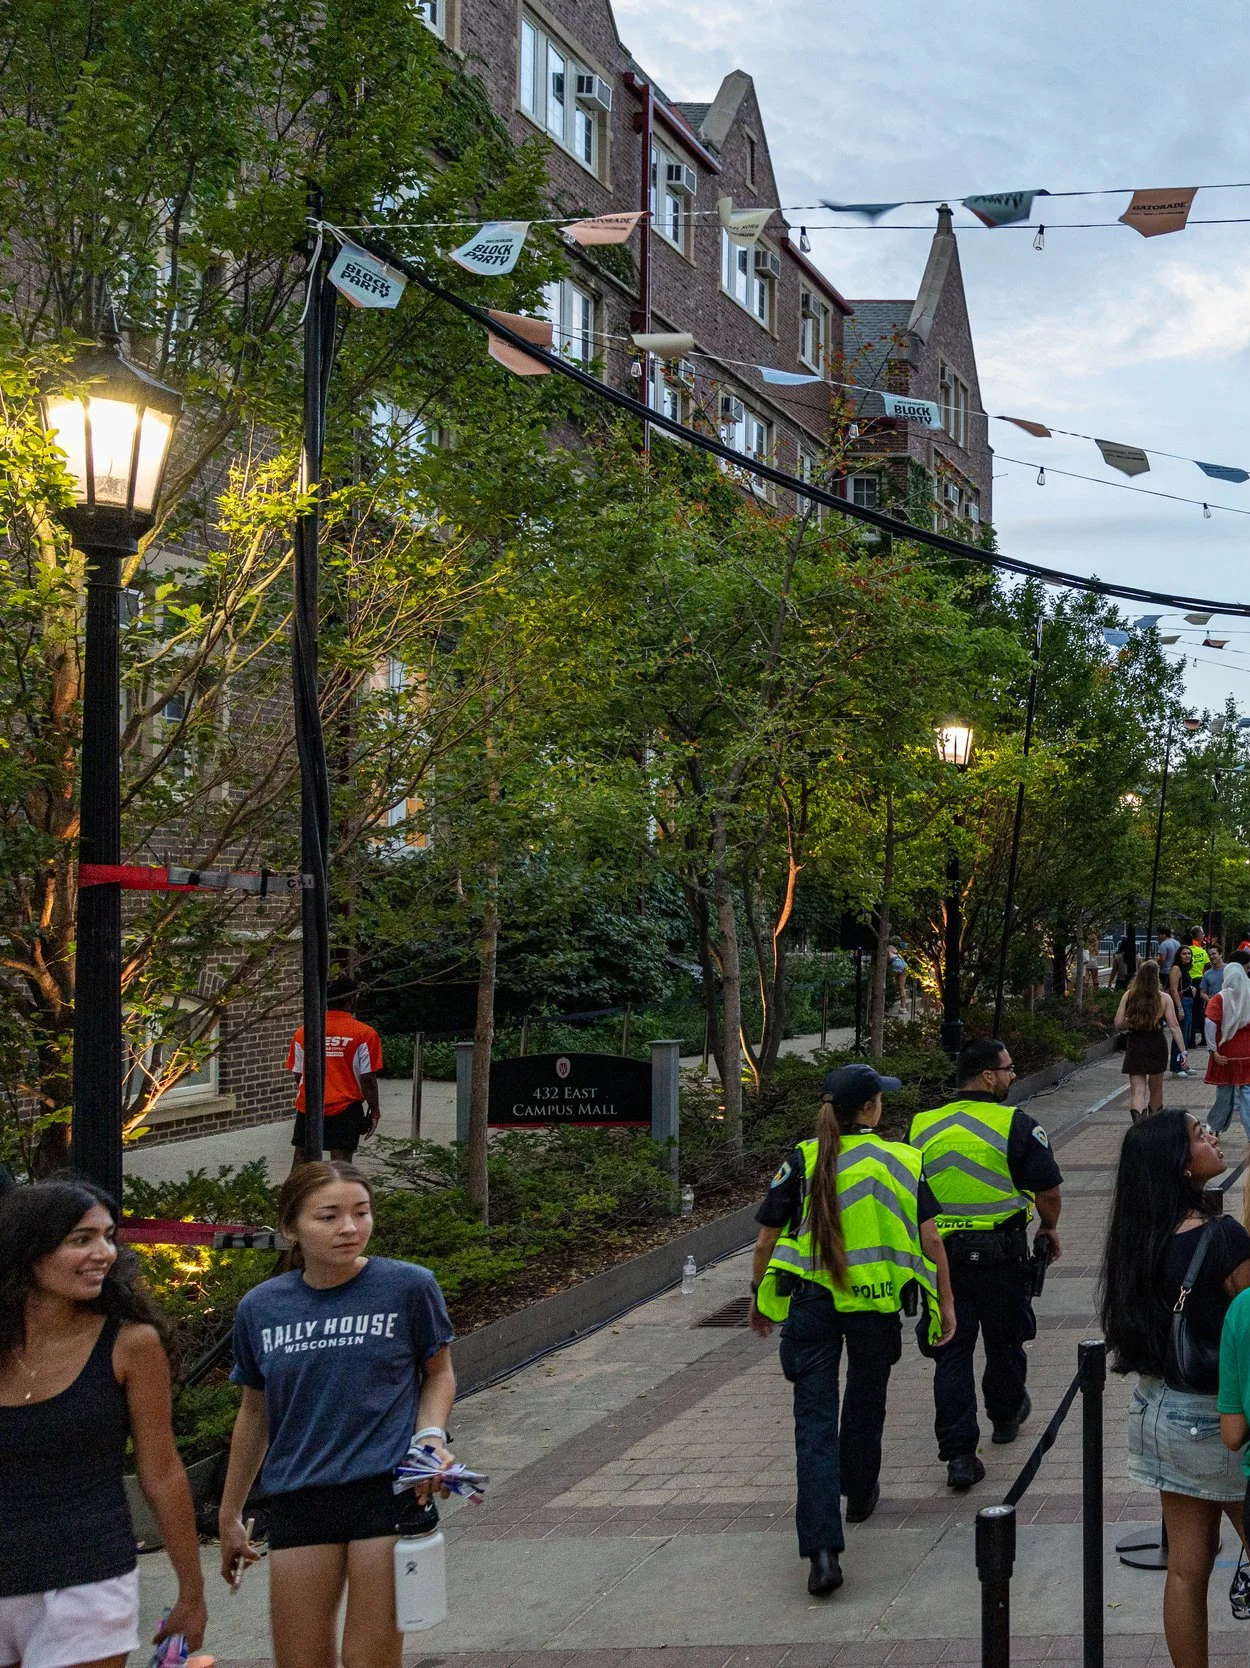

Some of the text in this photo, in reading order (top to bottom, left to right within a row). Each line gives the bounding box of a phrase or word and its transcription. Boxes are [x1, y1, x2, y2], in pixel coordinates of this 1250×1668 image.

[1133, 202, 1186, 210] GATORADE
[472, 244, 514, 255] BLOCK
[463, 251, 509, 266] PARTY
[340, 270, 389, 298] PARTY
[345, 263, 391, 293] BLOCK
[894, 405, 930, 416] BLOCK
[325, 1036, 354, 1047] EST
[533, 1086, 598, 1099] 432 EAST
[512, 1103, 618, 1116] CAMPUS MALL
[262, 1313, 399, 1354] RALLY HOUSE
[284, 1335, 364, 1354] WISCONSIN
